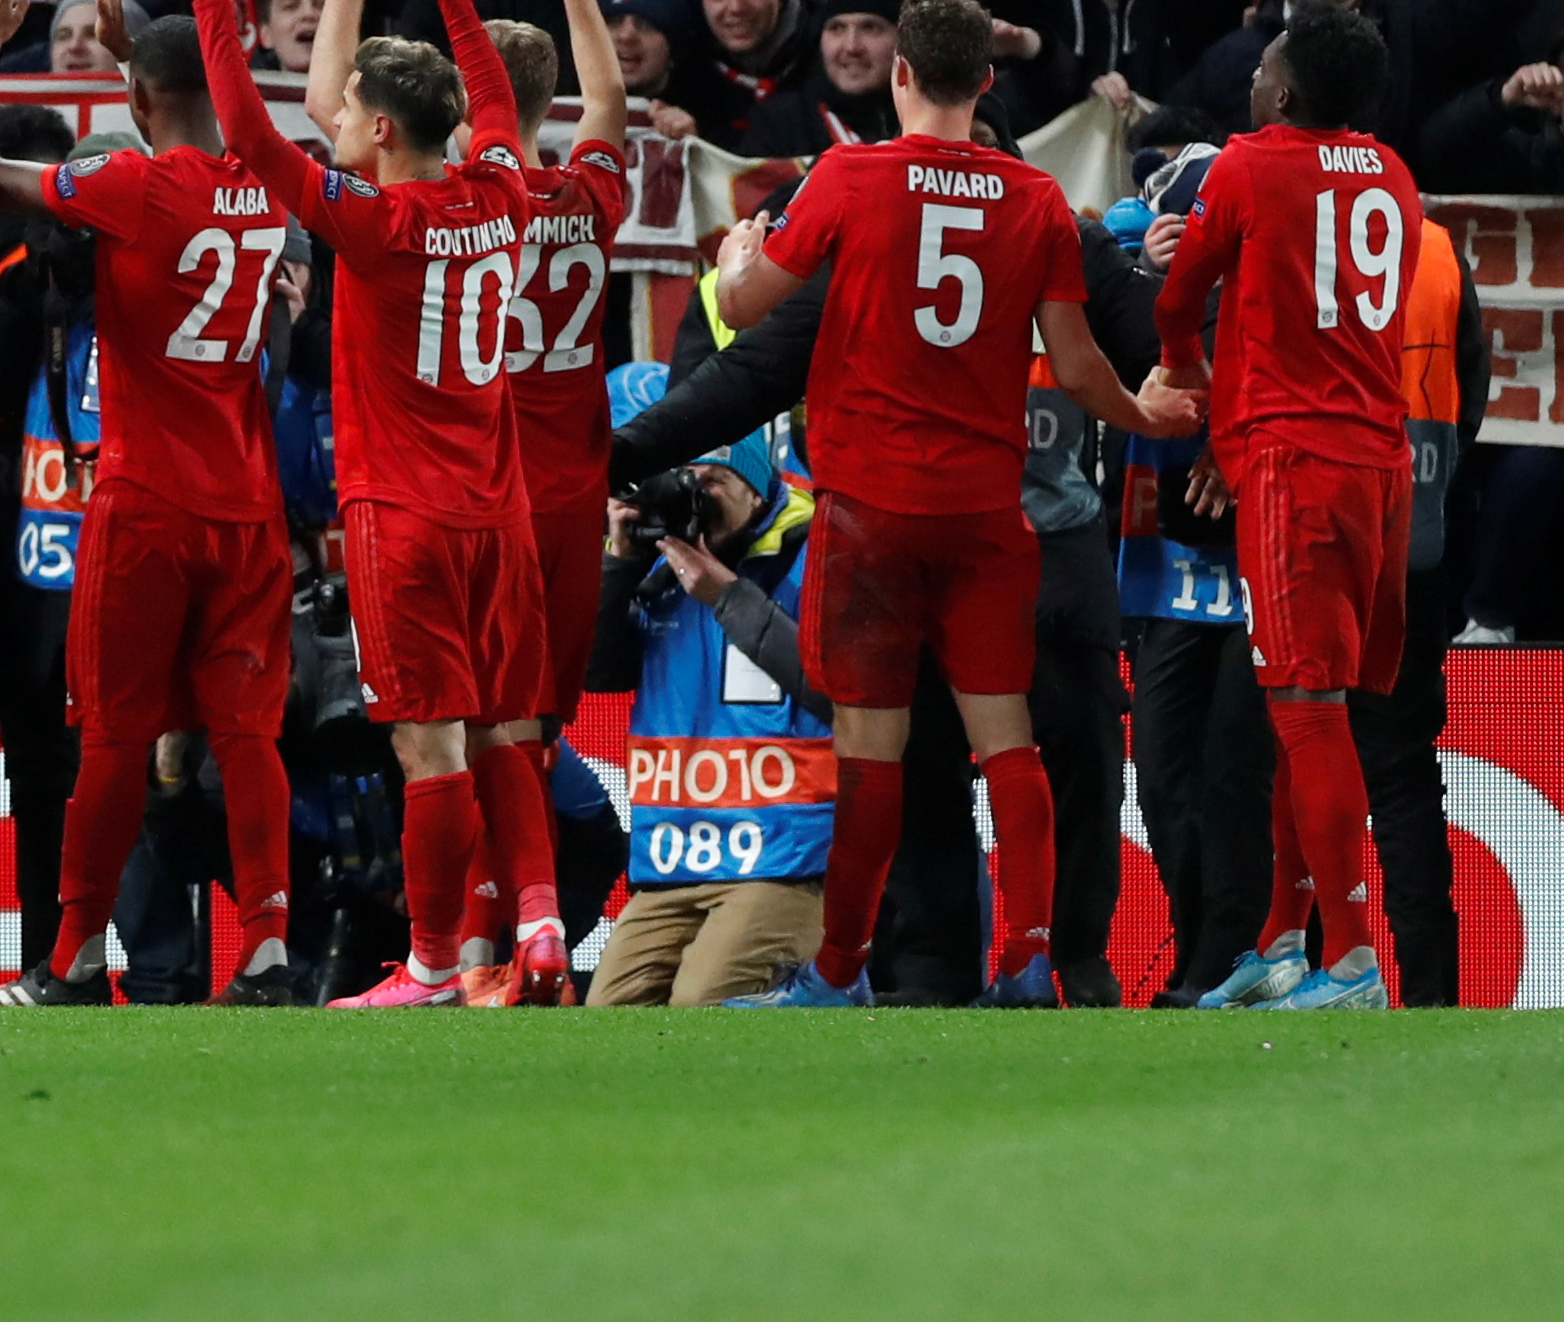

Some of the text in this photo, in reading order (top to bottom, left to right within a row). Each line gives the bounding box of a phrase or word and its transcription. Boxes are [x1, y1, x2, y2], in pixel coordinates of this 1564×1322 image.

[907, 164, 1004, 201] PAVARD
[1318, 145, 1384, 176] DAVIES
[213, 186, 270, 217] ALABA
[425, 216, 517, 257] COUTINHO
[524, 215, 596, 245] MMICH
[913, 203, 985, 349] 5
[1314, 187, 1404, 333] 19
[165, 226, 288, 364] 27
[418, 251, 515, 388] 10
[629, 745, 797, 803] PHOTO
[648, 820, 764, 875] 089
